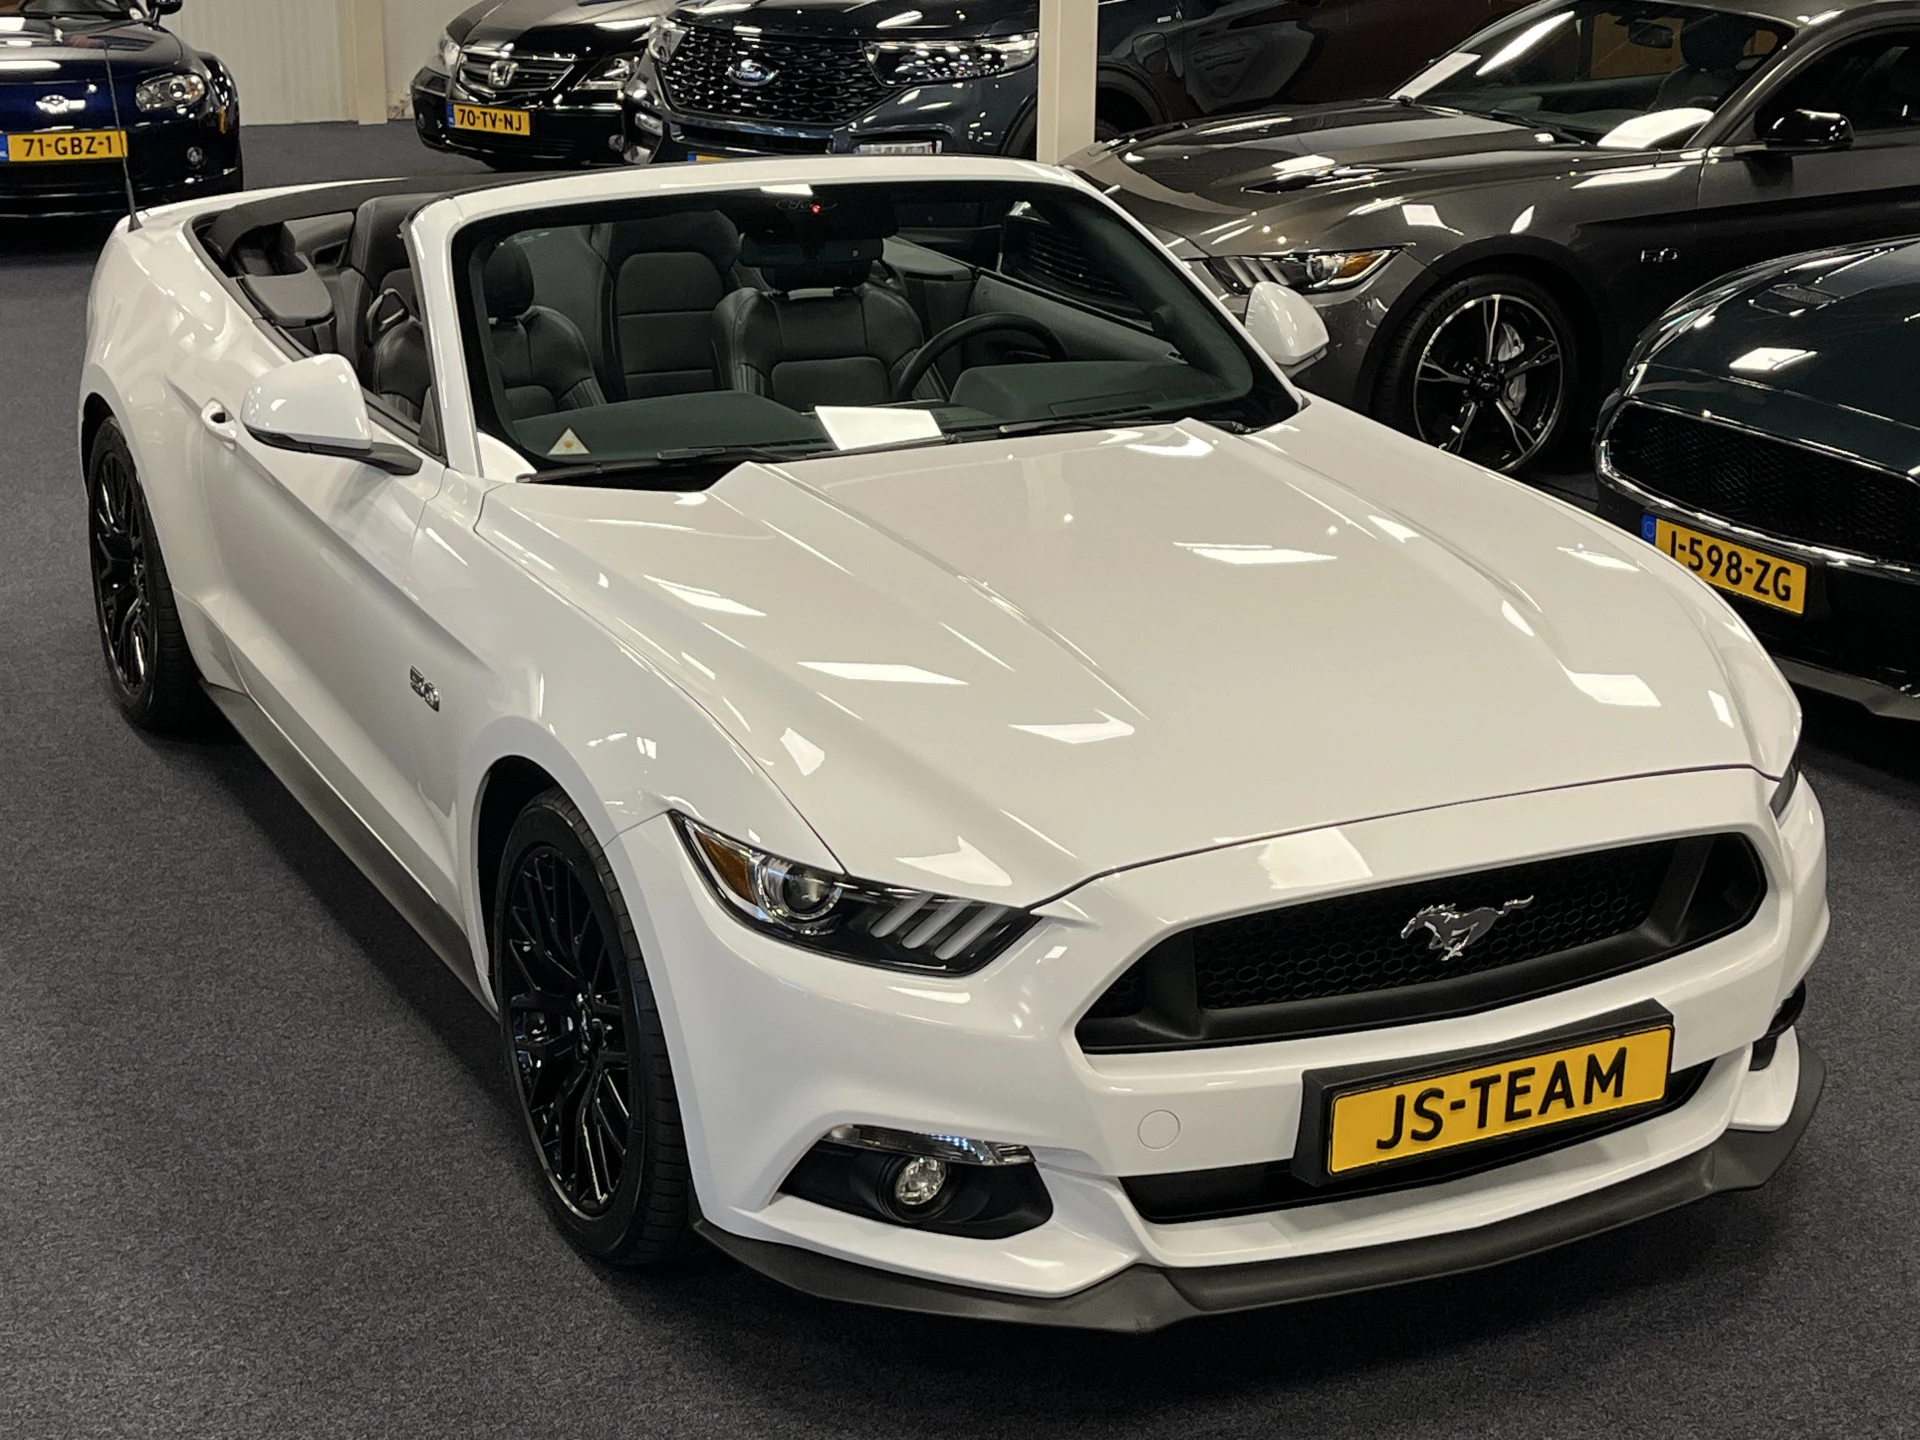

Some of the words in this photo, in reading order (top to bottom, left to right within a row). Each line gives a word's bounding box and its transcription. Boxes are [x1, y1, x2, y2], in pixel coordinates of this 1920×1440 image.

[458, 108, 522, 132] 70-TV-NJ
[23, 136, 112, 157] 71-GBZ-1
[1376, 1046, 1628, 1149] JS-TEAM
